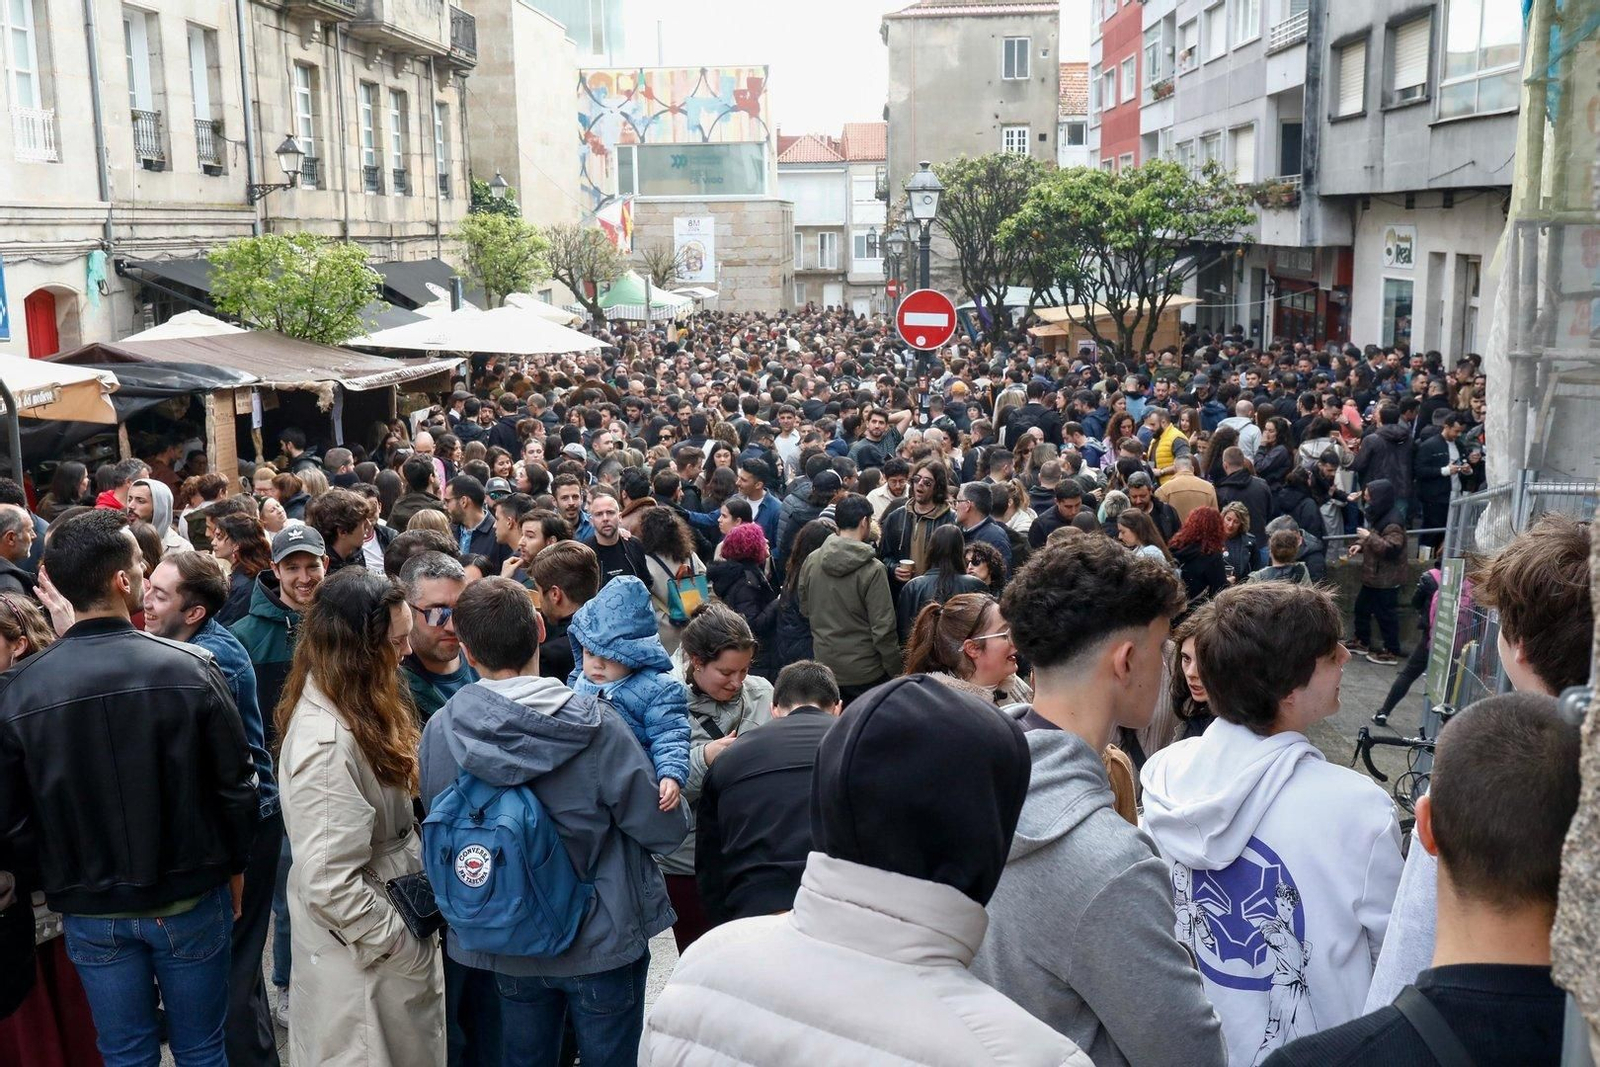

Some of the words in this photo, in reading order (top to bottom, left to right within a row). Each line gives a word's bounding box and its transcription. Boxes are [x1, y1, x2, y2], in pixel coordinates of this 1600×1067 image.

[687, 219, 701, 227] 8M
[1395, 239, 1413, 265] Real
[458, 847, 490, 863] CONVERSA
[466, 871, 488, 885] TABERNA
